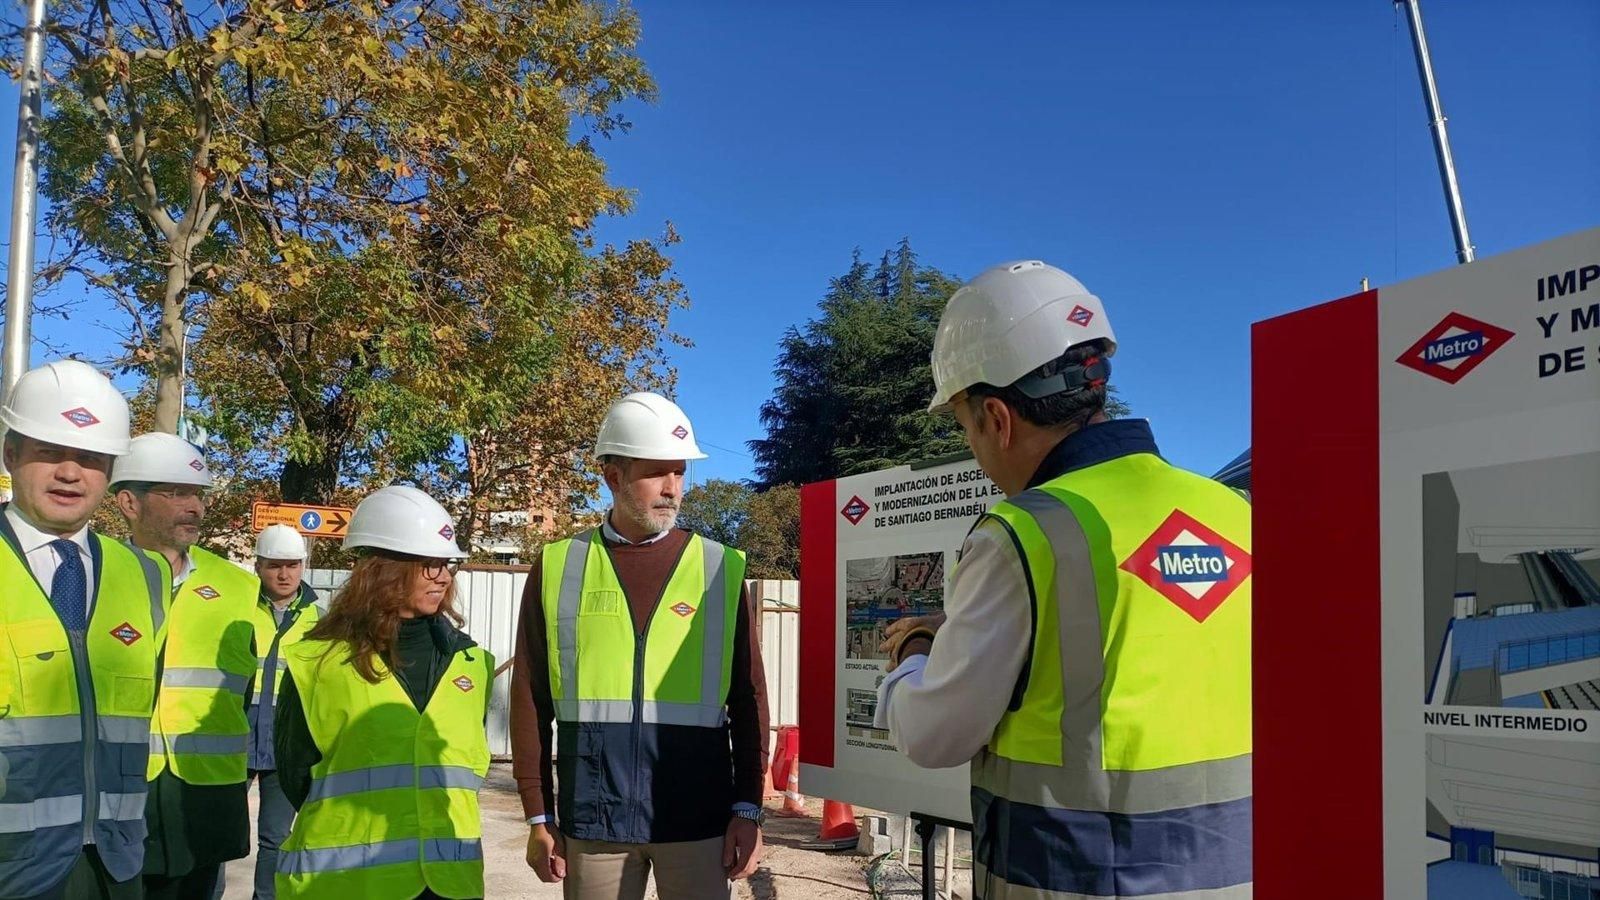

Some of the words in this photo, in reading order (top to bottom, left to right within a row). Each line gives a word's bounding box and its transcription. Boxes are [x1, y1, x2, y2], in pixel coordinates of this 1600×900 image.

[1537, 264, 1600, 301] IMP
[1536, 312, 1559, 338] Y
[1571, 303, 1600, 332] M
[1427, 338, 1479, 360] Metro
[1539, 346, 1585, 377] DE
[874, 475, 938, 497] IMPLANTACIÓN
[940, 474, 953, 486] DE
[875, 503, 880, 512] Y
[882, 489, 956, 512] MODERNIZACIÓN
[958, 487, 972, 500] DE
[975, 485, 988, 497] LA
[875, 518, 886, 528] DE
[888, 511, 931, 526] SANTIAGO
[934, 501, 986, 520] BERNABÉU
[1162, 552, 1223, 575] Metro
[862, 663, 879, 671] ACTUAL
[1424, 712, 1470, 727] NIVEL
[1475, 714, 1588, 732] INTERMEDIO
[866, 742, 898, 752] LONGITUDINAL
